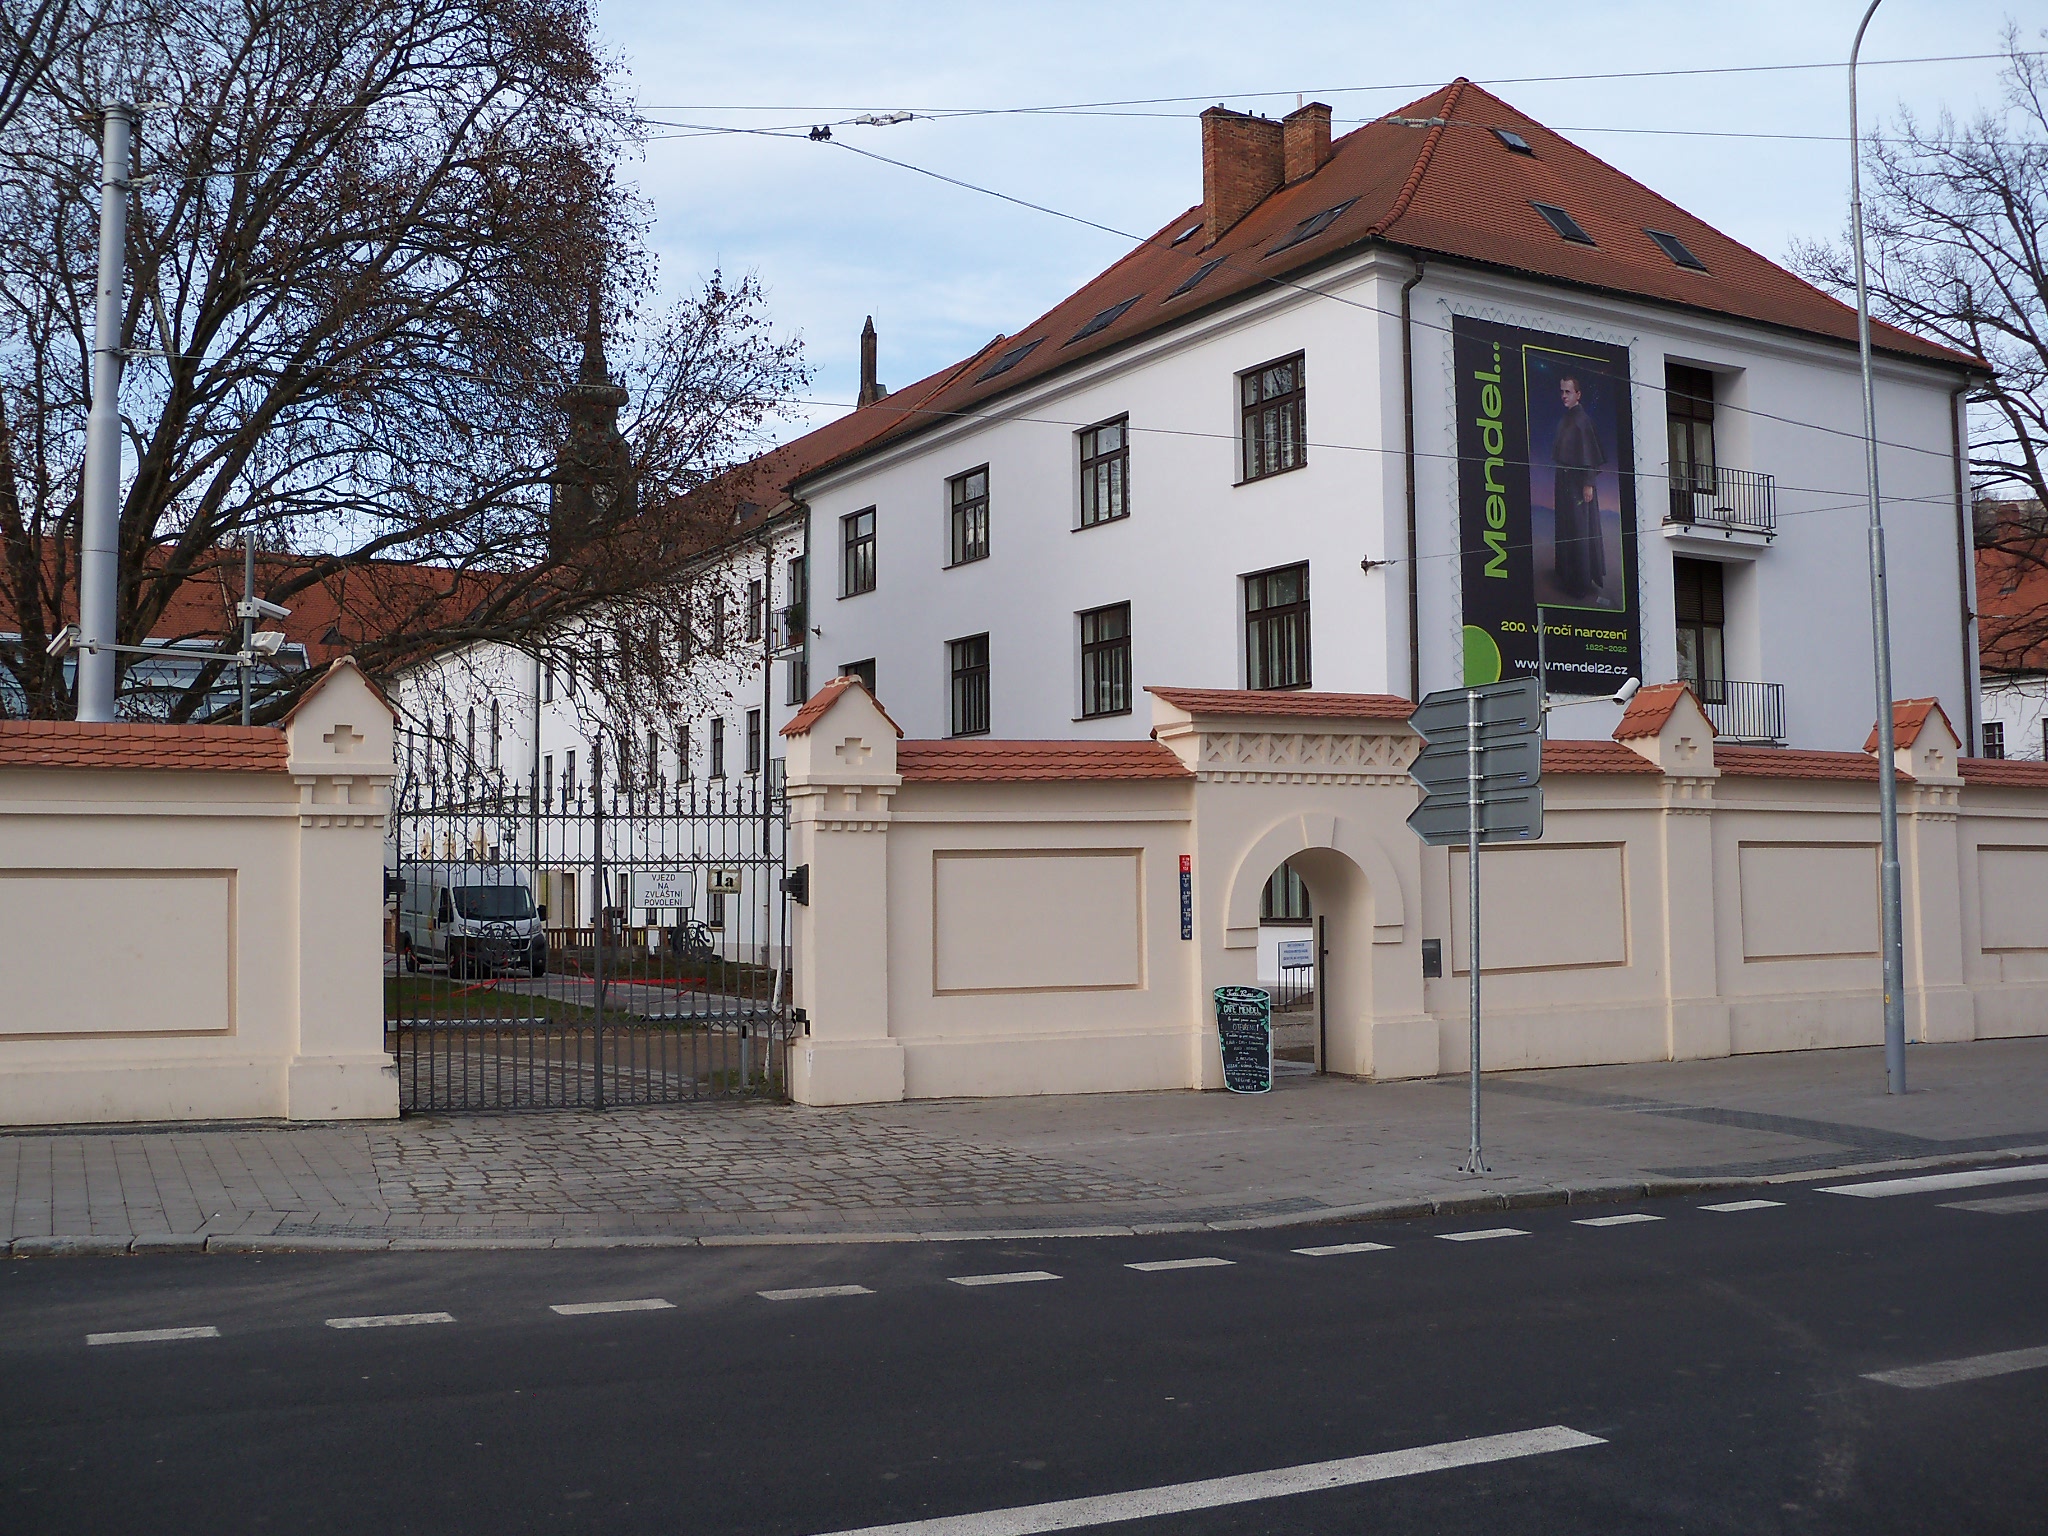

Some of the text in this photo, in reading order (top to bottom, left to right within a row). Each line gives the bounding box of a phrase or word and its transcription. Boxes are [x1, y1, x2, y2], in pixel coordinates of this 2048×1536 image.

[1474, 341, 1508, 578] Mendel...
[1500, 621, 1528, 633] 200.
[1575, 628, 1628, 641] narození
[651, 874, 676, 882] VJEZD
[714, 870, 734, 888] 1a
[657, 882, 669, 890] NA
[645, 888, 683, 898] ZVLÁŠTNÍ
[644, 898, 683, 906] POVOLENÍ
